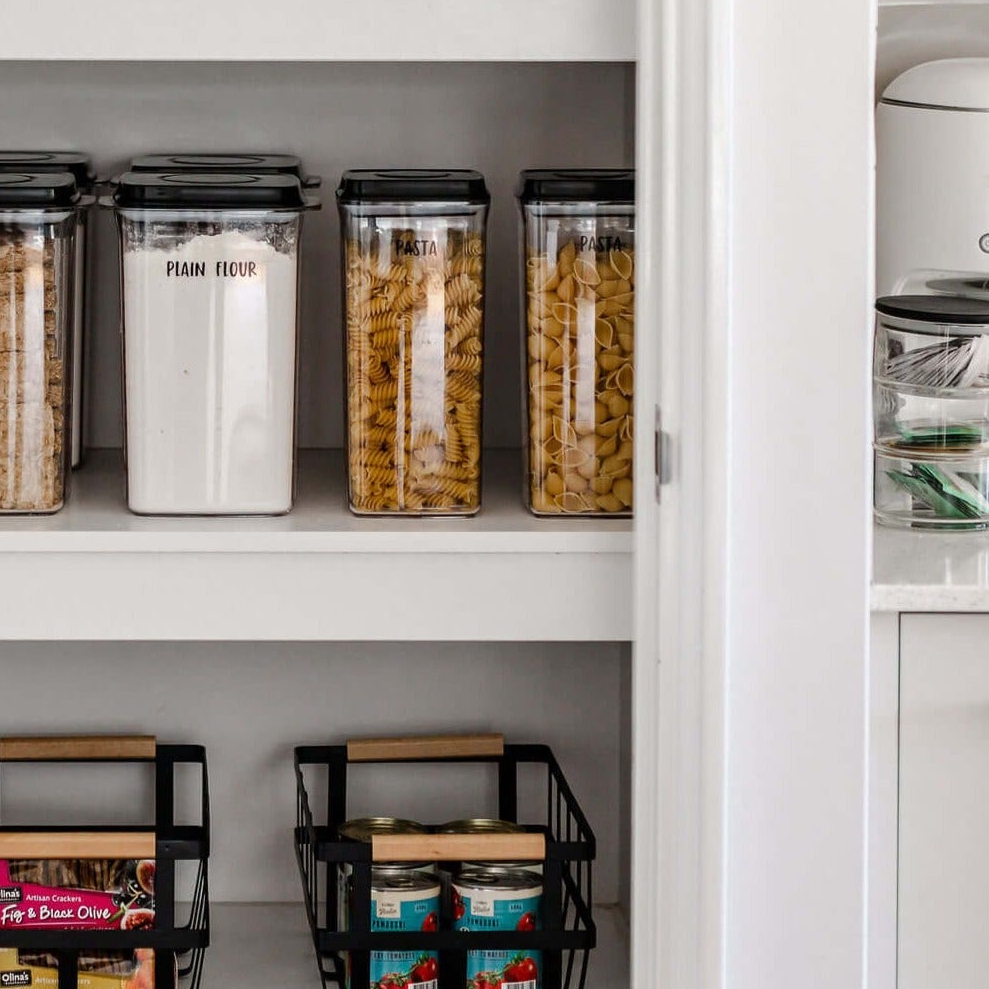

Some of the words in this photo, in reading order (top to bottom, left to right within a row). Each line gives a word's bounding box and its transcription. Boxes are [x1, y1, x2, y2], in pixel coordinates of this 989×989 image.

[395, 240, 438, 257] PASTA
[580, 236, 622, 253] PASTA
[166, 261, 206, 277] PLAIN
[216, 261, 258, 277] FLOUR
[25, 894, 50, 902] Artisan
[52, 894, 82, 902] Crackers
[1, 904, 26, 926] Fig
[27, 907, 37, 919] &
[39, 905, 75, 920] Black
[77, 905, 112, 920] Olive
[1, 971, 29, 982] Olina's
